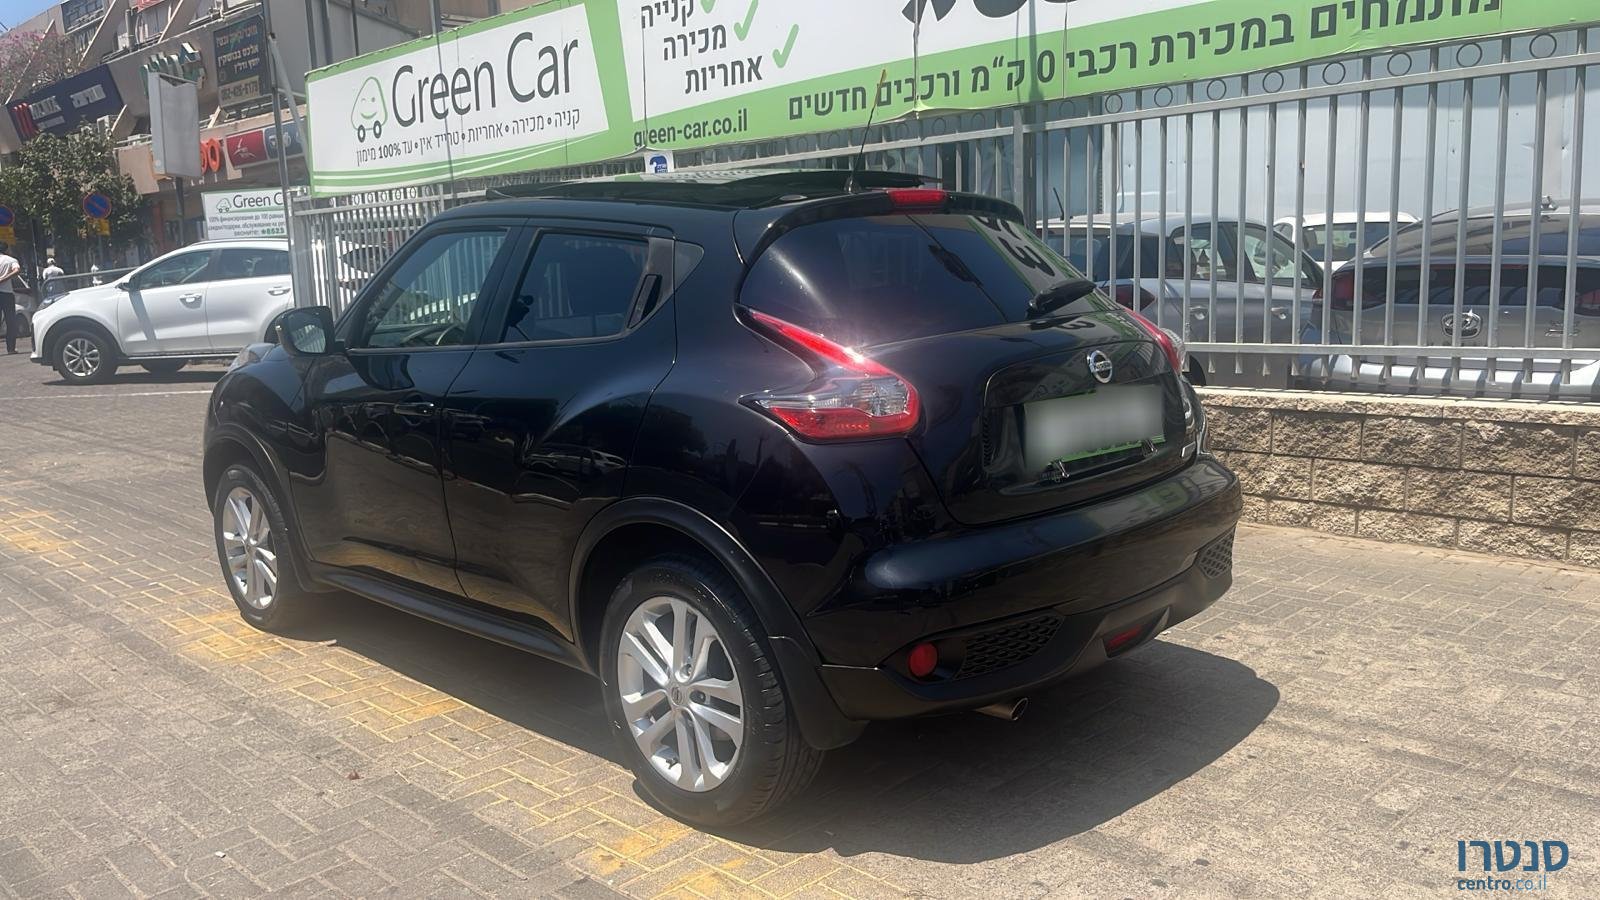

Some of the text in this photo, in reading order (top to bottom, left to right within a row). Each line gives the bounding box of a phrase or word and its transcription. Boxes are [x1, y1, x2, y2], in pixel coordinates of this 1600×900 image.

[641, 0, 694, 29] קנייה
[663, 24, 727, 61] מכירה
[1149, 13, 1295, 66] במכירת
[685, 55, 763, 95] אחריות
[1036, 49, 1056, 83] 0
[1065, 41, 1138, 78] רכבי
[392, 31, 579, 128] Green Car
[876, 70, 960, 108] ורכבים
[789, 86, 867, 120] חדשים
[468, 123, 503, 143] אחריות
[513, 115, 544, 135] מכירה
[554, 109, 580, 130] קניה
[633, 108, 748, 150] green-car.co.il
[356, 147, 376, 167] מימון
[378, 142, 402, 159] 100%
[402, 140, 412, 154] עד
[419, 136, 433, 155] אין
[233, 194, 271, 208] Green
